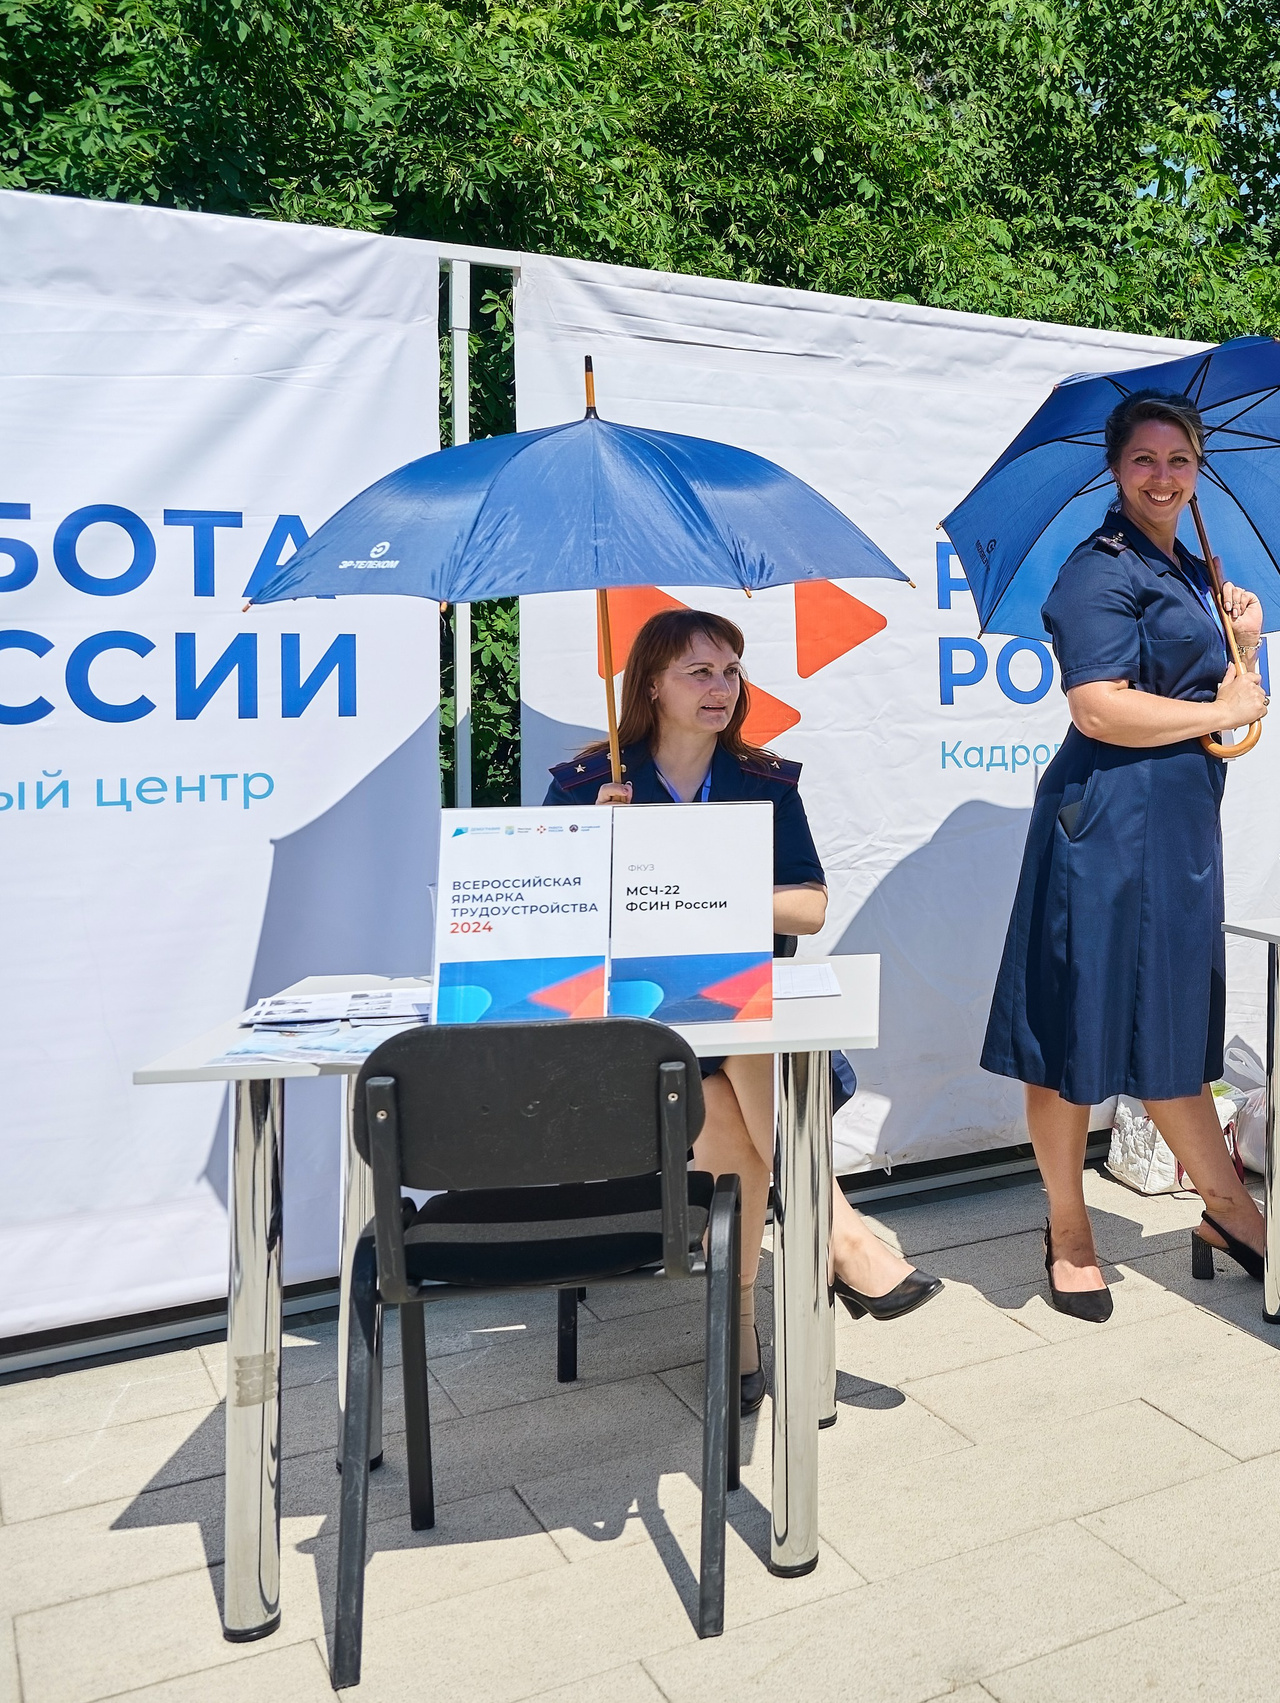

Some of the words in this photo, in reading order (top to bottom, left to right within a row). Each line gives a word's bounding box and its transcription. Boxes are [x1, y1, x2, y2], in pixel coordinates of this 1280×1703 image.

[338, 560, 400, 569] ЭР-ТЕЛЕКОМ
[941, 740, 1061, 774] Кадро
[96, 771, 275, 812] центр
[628, 863, 655, 872] ФКУЗ
[452, 876, 582, 891] ВСЕРОССИЙСКАЯ
[626, 885, 680, 896] МСЧ-22
[451, 892, 525, 904] ЯРМАРКА
[450, 902, 599, 918] ТРУДОУСТРОЙСТВА
[625, 900, 670, 912] ФСИН
[675, 900, 728, 911] России
[449, 921, 493, 934] 2024
